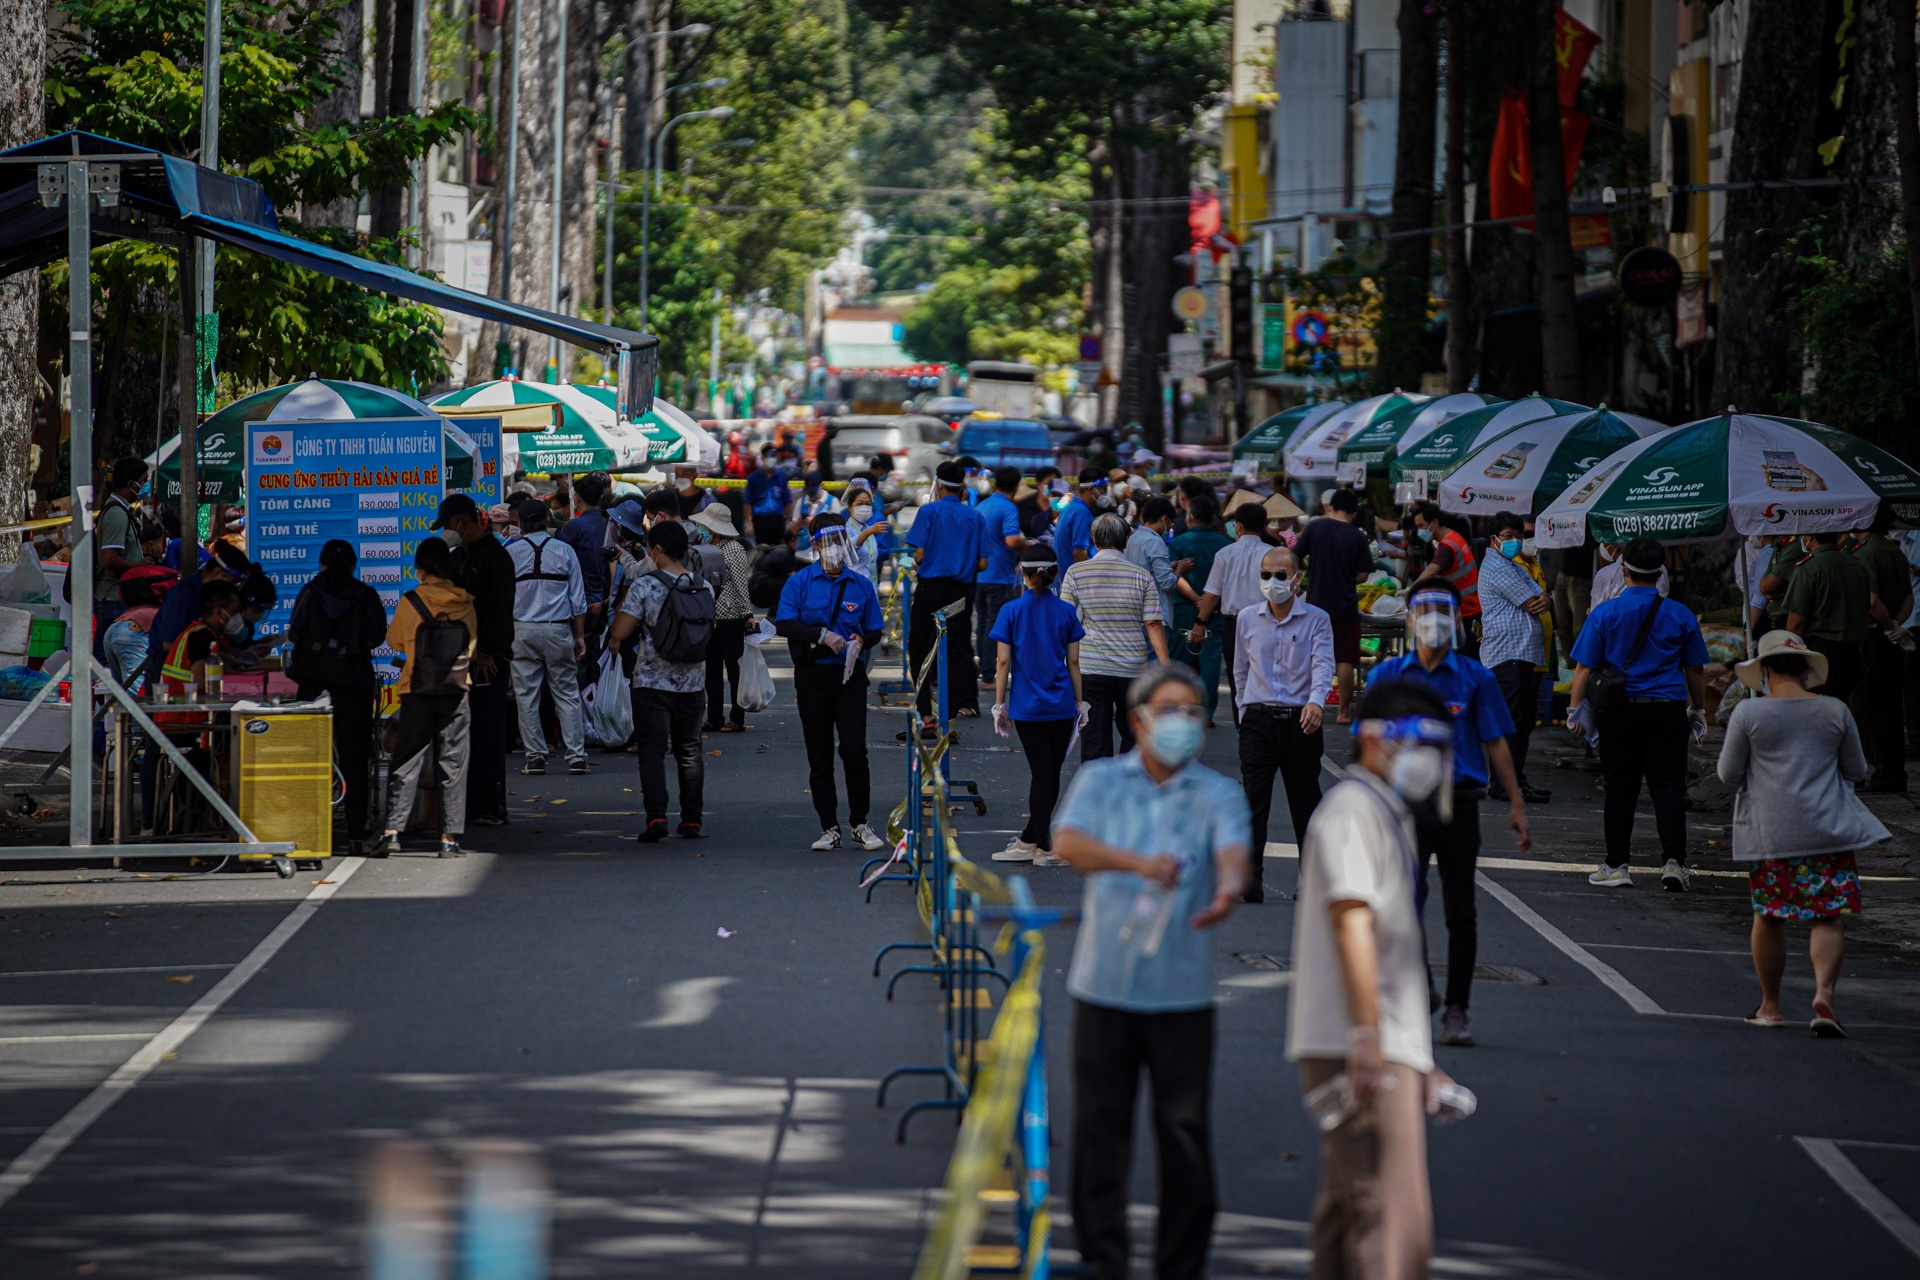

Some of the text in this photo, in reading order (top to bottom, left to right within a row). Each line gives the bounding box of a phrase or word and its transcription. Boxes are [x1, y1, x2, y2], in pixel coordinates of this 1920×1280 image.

[295, 430, 436, 456] CÔNG TY TNHH TUẤN NGUYỄN
[467, 427, 494, 447] UYỄN
[536, 452, 594, 469] (028) 38272727
[259, 473, 290, 489] CUNG
[293, 469, 317, 488] ỨNG
[320, 466, 350, 487] THỦY
[353, 465, 374, 487] HẢI
[376, 464, 399, 486] SẢN
[401, 467, 422, 486] GIÁ
[423, 464, 439, 485] RẺ
[1356, 468, 1364, 484] 2
[167, 480, 182, 499] (02
[1417, 477, 1424, 495] 1
[1629, 484, 1682, 495] VINASUN
[1683, 482, 1705, 491] APP
[260, 496, 331, 511] TÔM CÀNG
[360, 500, 398, 509] 130.000đ
[402, 491, 438, 509] K/Kg
[1478, 493, 1505, 501] VINASUN
[1791, 507, 1853, 516] VINASUN APP
[260, 521, 319, 536] TÔM THẺ
[359, 525, 398, 534] 135.000đ
[1612, 512, 1699, 537] (028) 38272727
[261, 547, 307, 560] NGHÊU
[365, 549, 399, 558] 60.000đ
[361, 574, 400, 583] 170.000đ
[261, 620, 280, 635] ỐC
